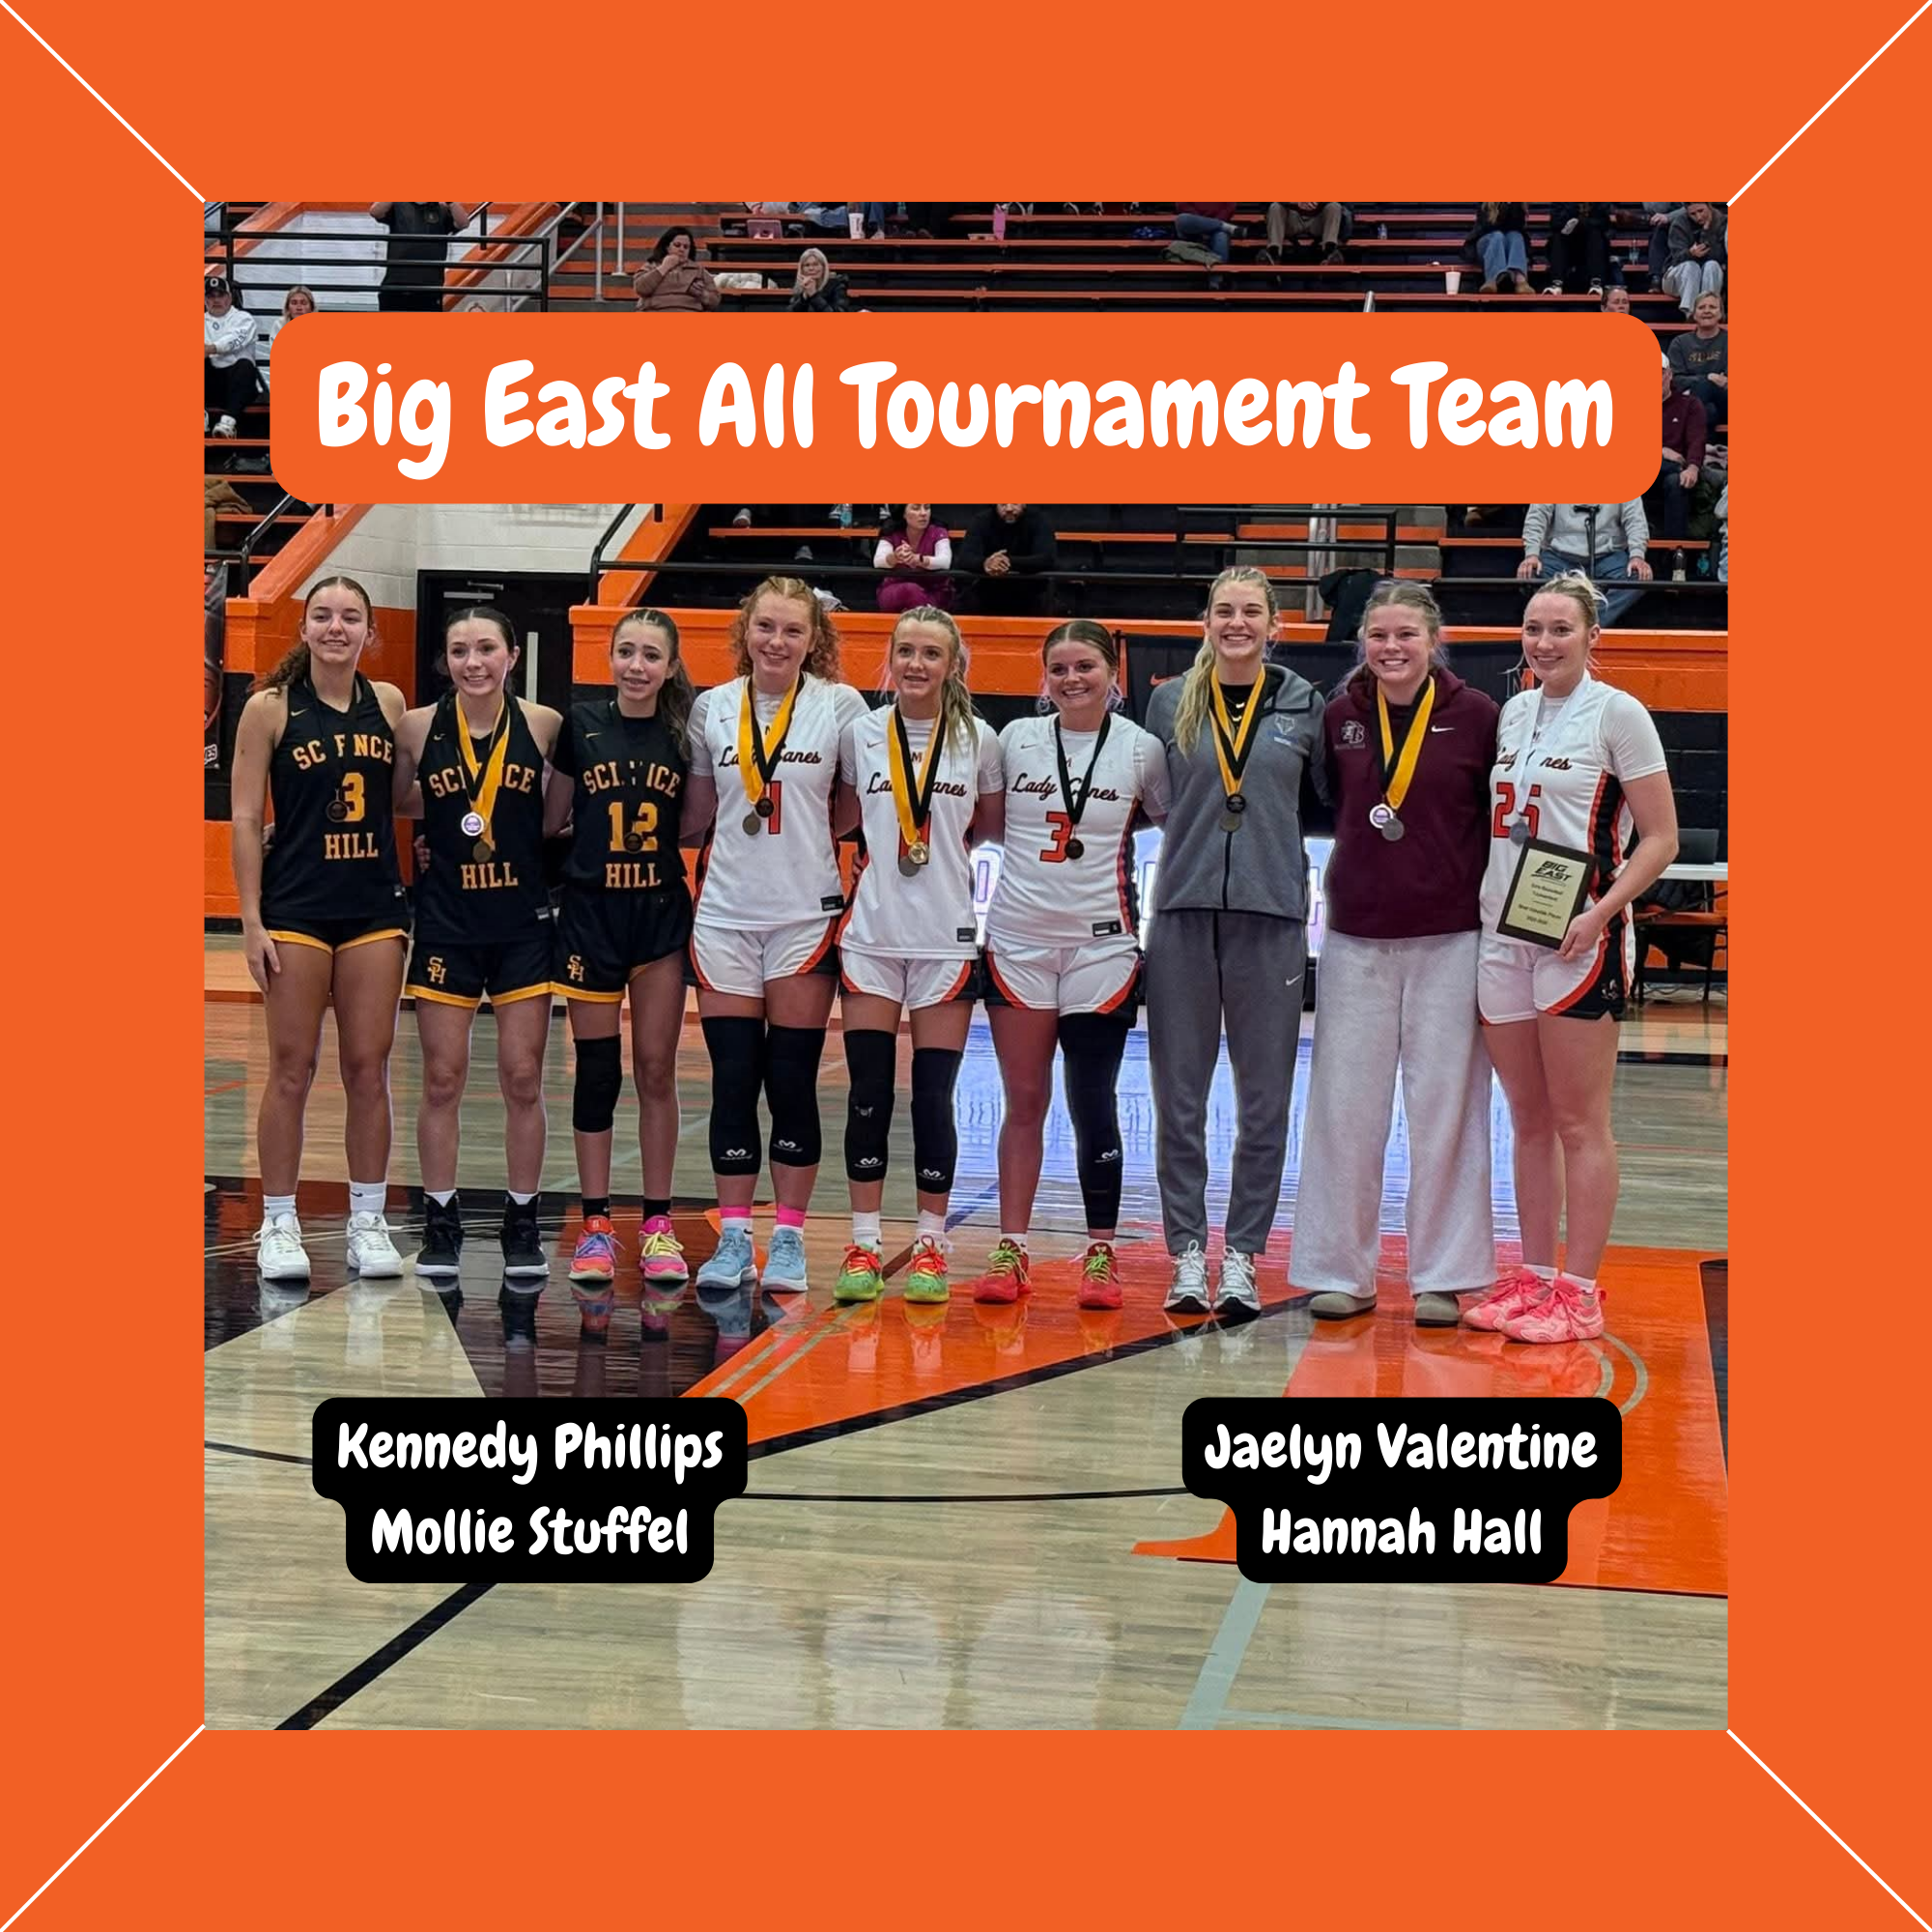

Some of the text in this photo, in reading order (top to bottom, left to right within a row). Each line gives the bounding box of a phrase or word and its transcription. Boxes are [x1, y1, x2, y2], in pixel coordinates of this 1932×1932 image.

[293, 733, 394, 770] SCENCE
[781, 751, 822, 764] anes
[342, 772, 365, 822] 3
[930, 781, 967, 797] anes
[1010, 773, 1058, 801] Lady
[608, 802, 658, 852] 12
[1038, 810, 1074, 864] 3
[324, 832, 380, 860] HILL
[460, 862, 519, 890] HILL
[605, 862, 663, 889] HILL
[1534, 867, 1573, 881] EAST
[1542, 860, 1569, 872] BIG
